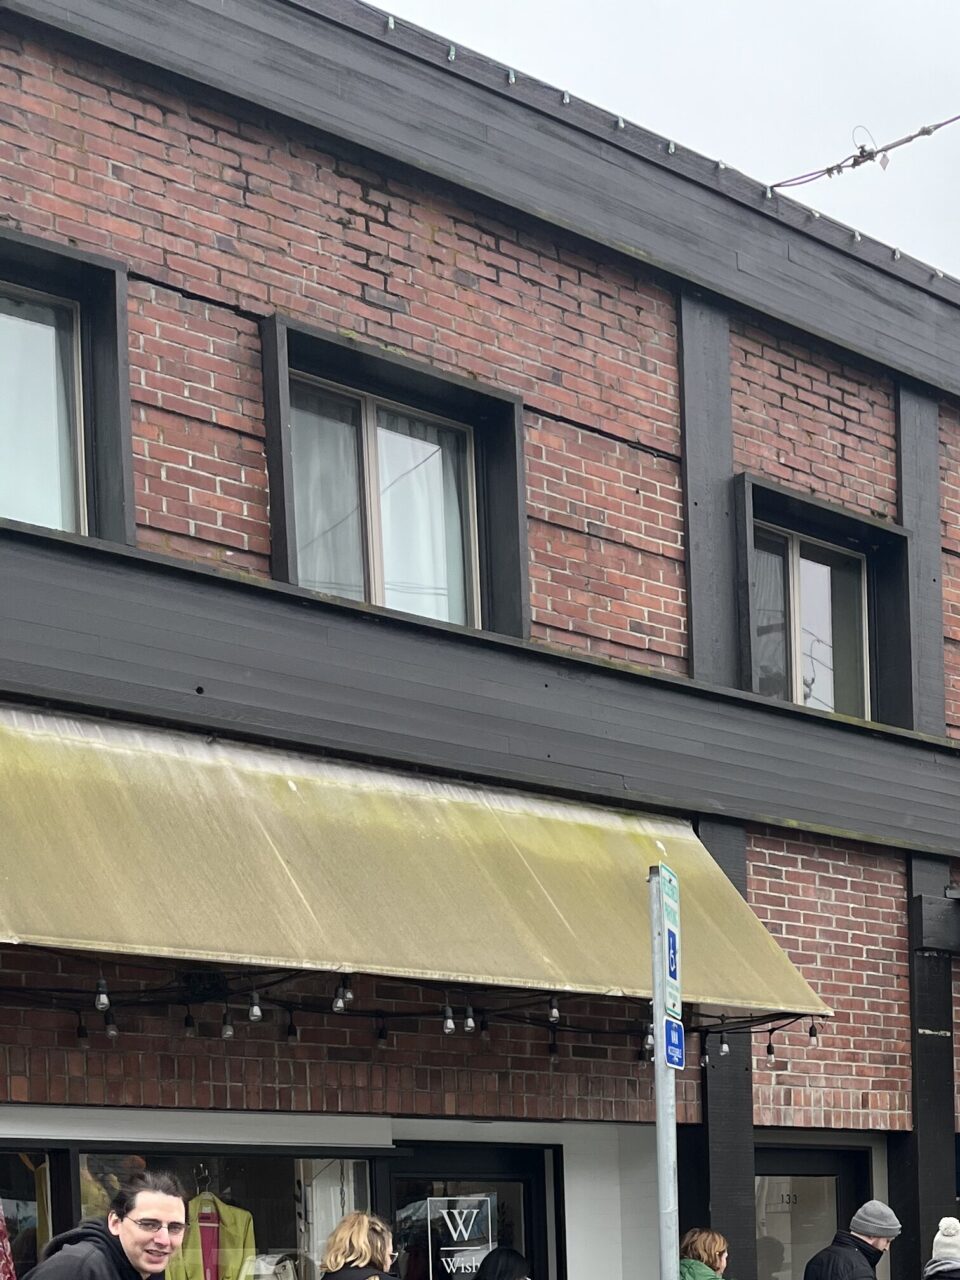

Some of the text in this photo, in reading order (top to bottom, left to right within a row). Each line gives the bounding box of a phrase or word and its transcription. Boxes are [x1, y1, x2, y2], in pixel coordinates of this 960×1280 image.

[780, 1193, 798, 1205] 133
[440, 1209, 480, 1241] W
[441, 1256, 480, 1274] Wish
